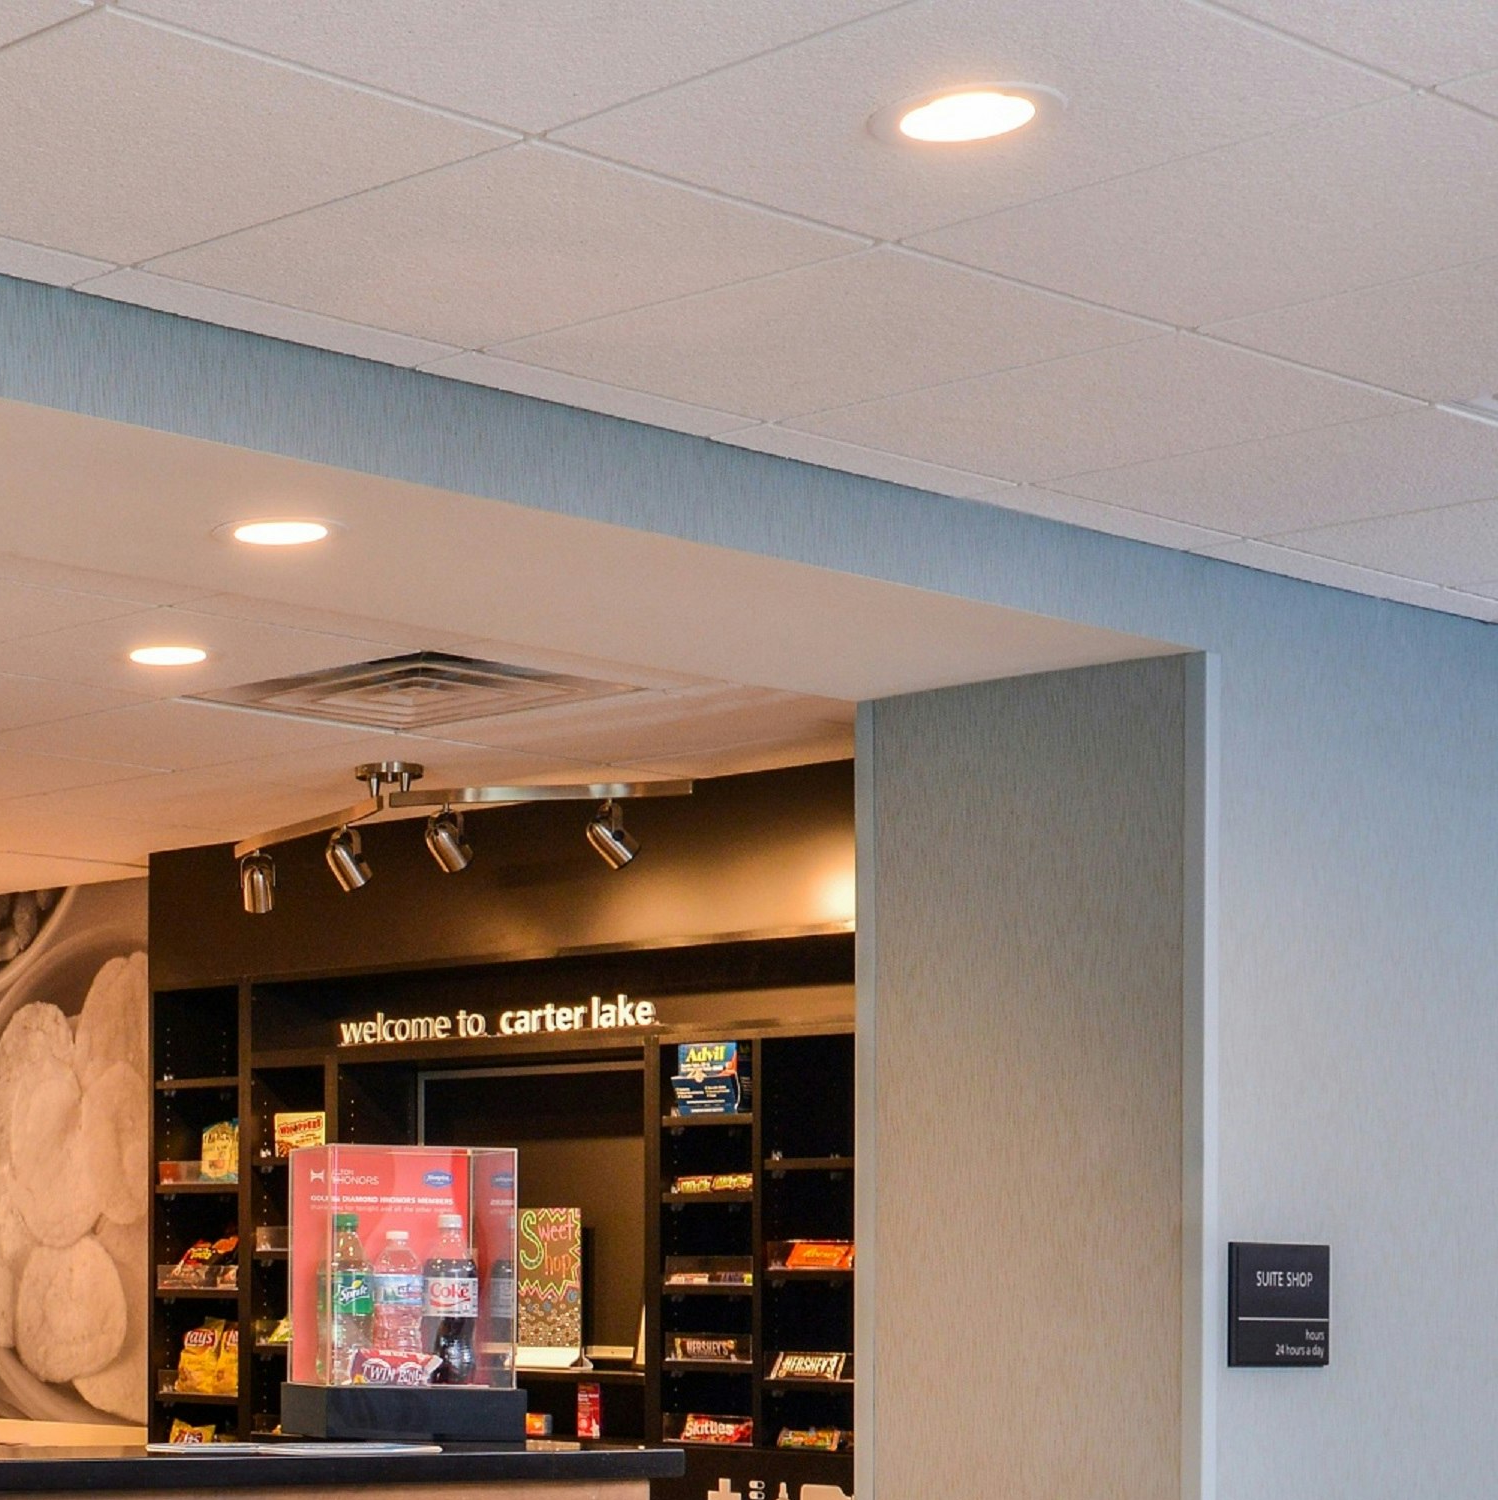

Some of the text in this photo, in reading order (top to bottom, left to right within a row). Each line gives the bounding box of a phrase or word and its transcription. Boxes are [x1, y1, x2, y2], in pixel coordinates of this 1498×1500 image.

[339, 993, 656, 1045] welcome to carter lake
[686, 1045, 726, 1063] Advil
[1256, 1270, 1313, 1288] SUITE SHOP
[429, 1282, 469, 1300] Coke
[1305, 1328, 1325, 1341] hours
[1275, 1343, 1285, 1356] 24
[1286, 1343, 1305, 1356] hours
[1311, 1344, 1325, 1359] day
[361, 1362, 397, 1382] TWIN
